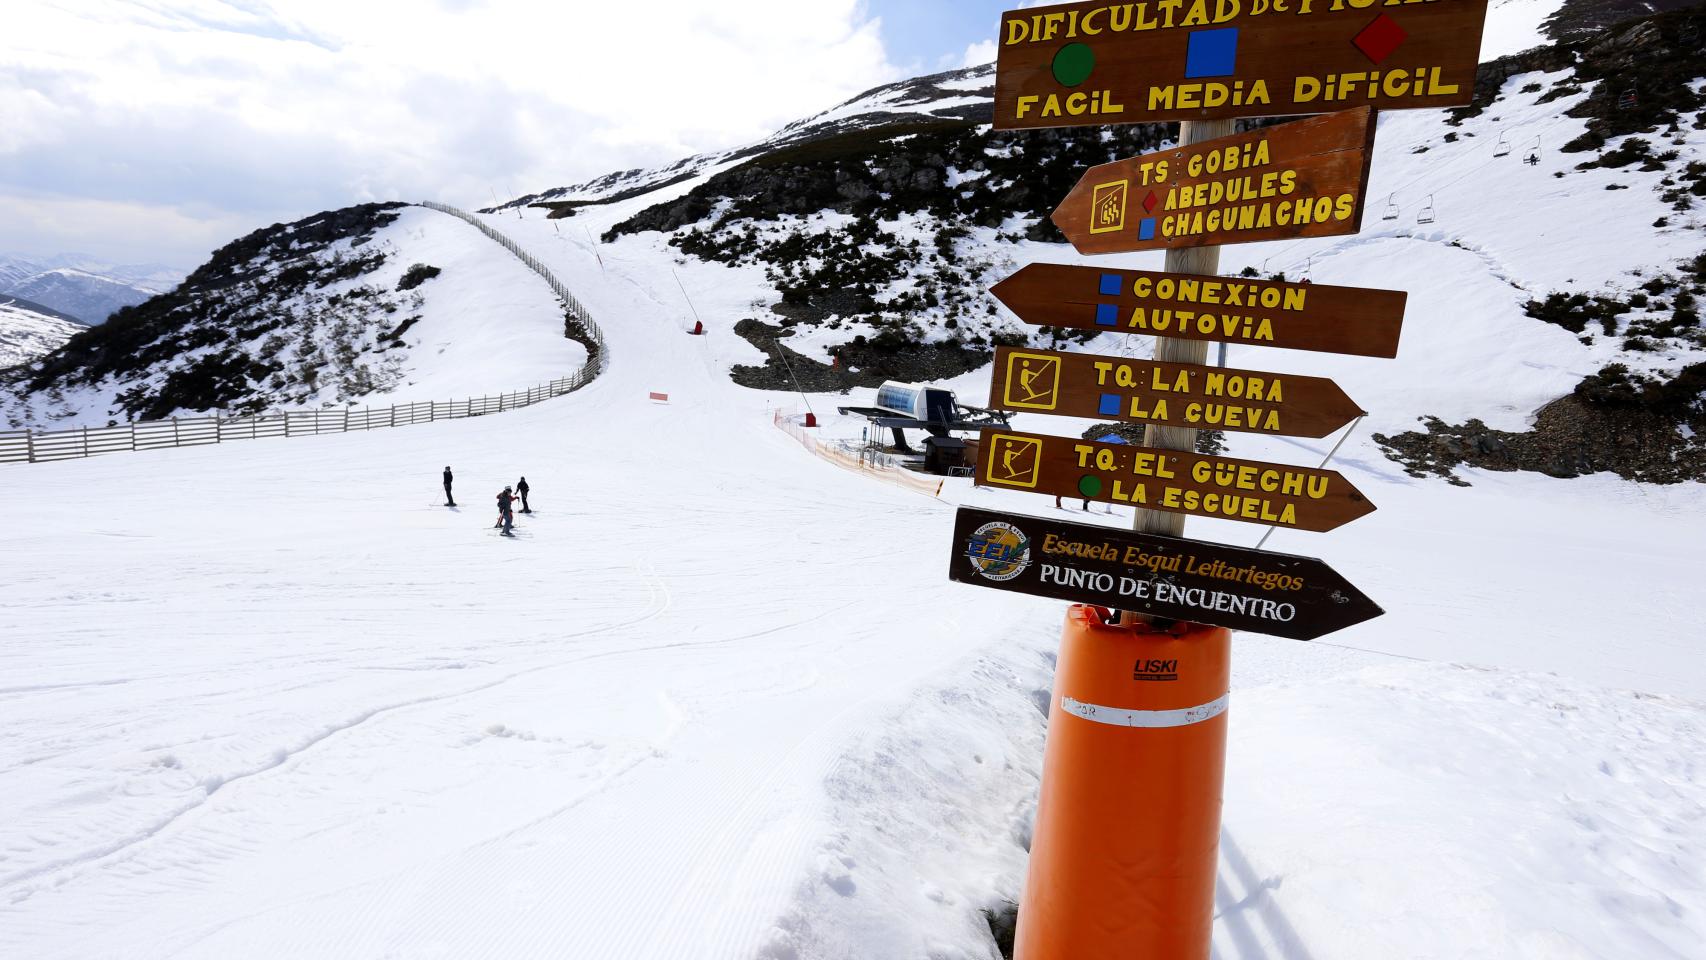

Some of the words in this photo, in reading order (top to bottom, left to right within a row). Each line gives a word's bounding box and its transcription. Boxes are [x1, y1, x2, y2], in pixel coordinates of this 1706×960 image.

[1006, 0, 1241, 45] DIFICULTAD
[1164, 169, 1297, 211] ABEDULES
[1161, 193, 1354, 237] CHAGUNACHOS
[1151, 367, 1190, 393] LA
[1204, 372, 1283, 403] MORA
[1129, 396, 1169, 421] LA
[1185, 402, 1280, 431] CUEVA
[1133, 452, 1175, 479] EL
[1191, 460, 1329, 499] GÜECHU
[1111, 479, 1147, 504] LA
[1162, 486, 1296, 525] ESCUELA
[1041, 533, 1118, 561] Escuela
[1184, 555, 1304, 591] Leitariegos
[1039, 563, 1114, 593] PUNTO
[1119, 576, 1151, 600] DE
[1155, 582, 1297, 623] ENCUENTRO
[1134, 659, 1178, 673] LISKI
